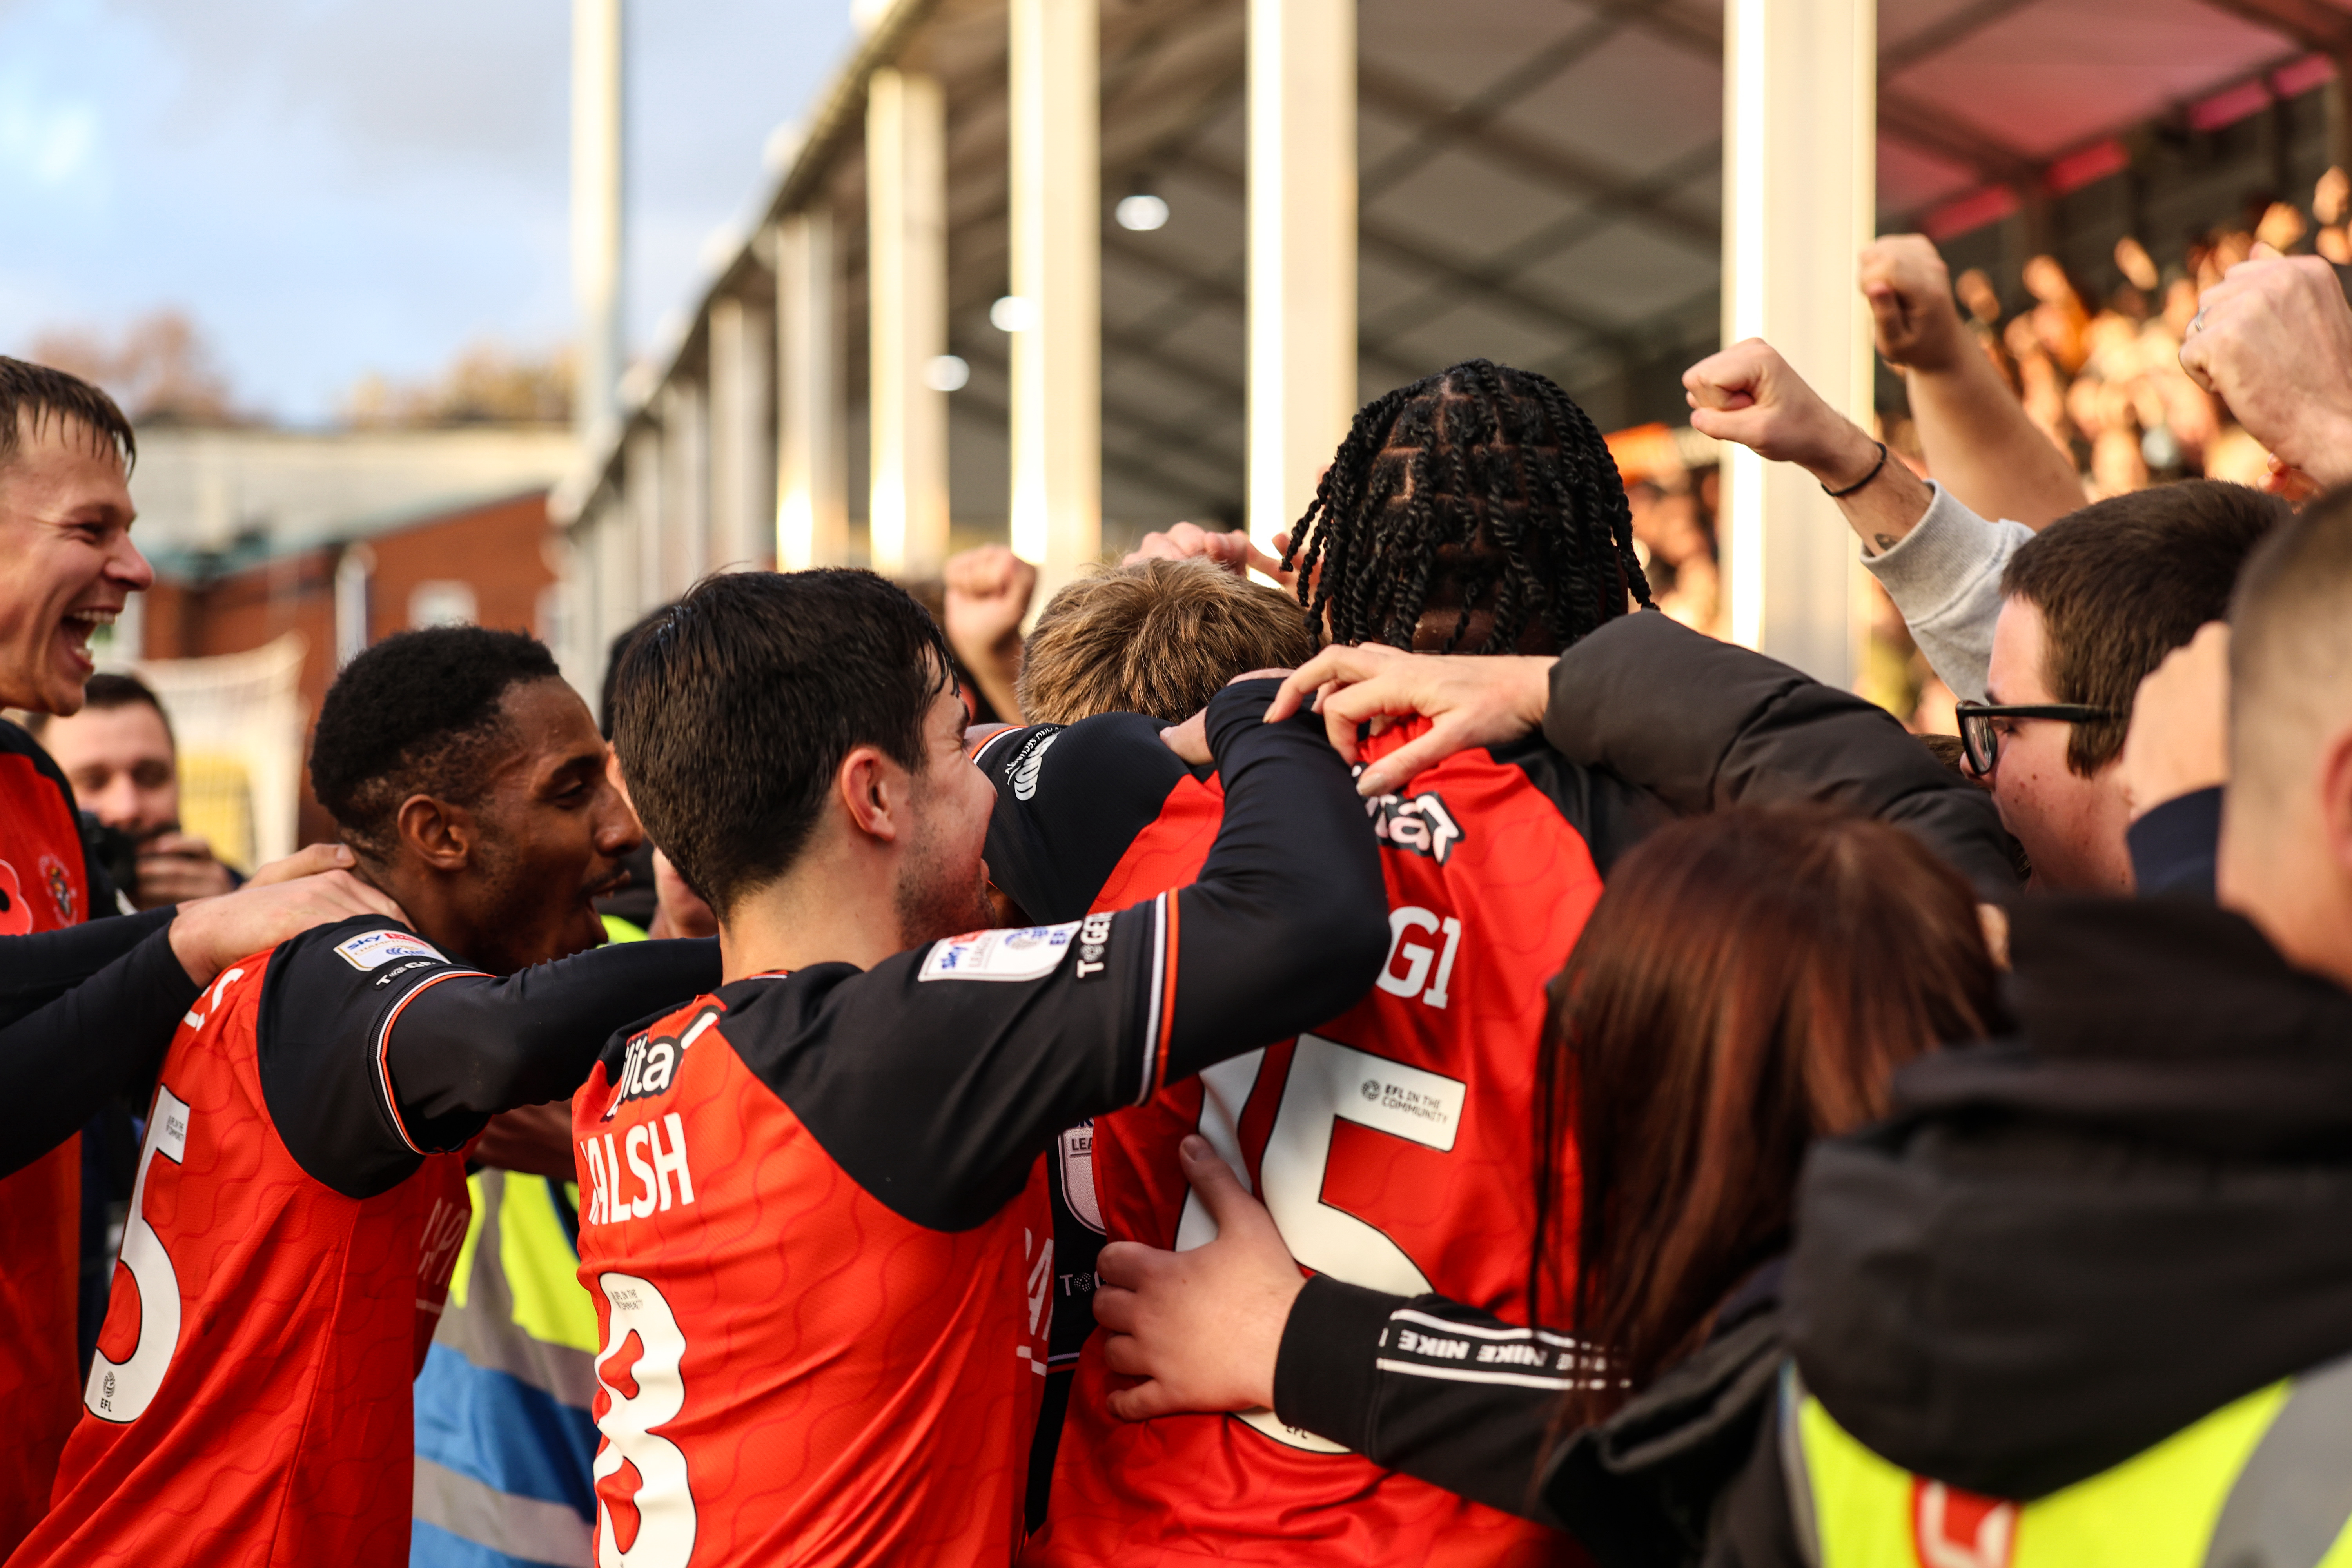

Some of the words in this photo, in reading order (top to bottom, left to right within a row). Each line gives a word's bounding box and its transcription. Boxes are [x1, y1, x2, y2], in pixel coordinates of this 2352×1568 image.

[347, 935, 381, 950] sky
[1375, 906, 1462, 1010] GI
[1381, 1096, 1449, 1125] COMMUNITY
[579, 1112, 695, 1226] ALSH
[1397, 1329, 1471, 1359] NIKE
[1476, 1344, 1548, 1367] NIKE
[100, 1397, 112, 1412] EFL
